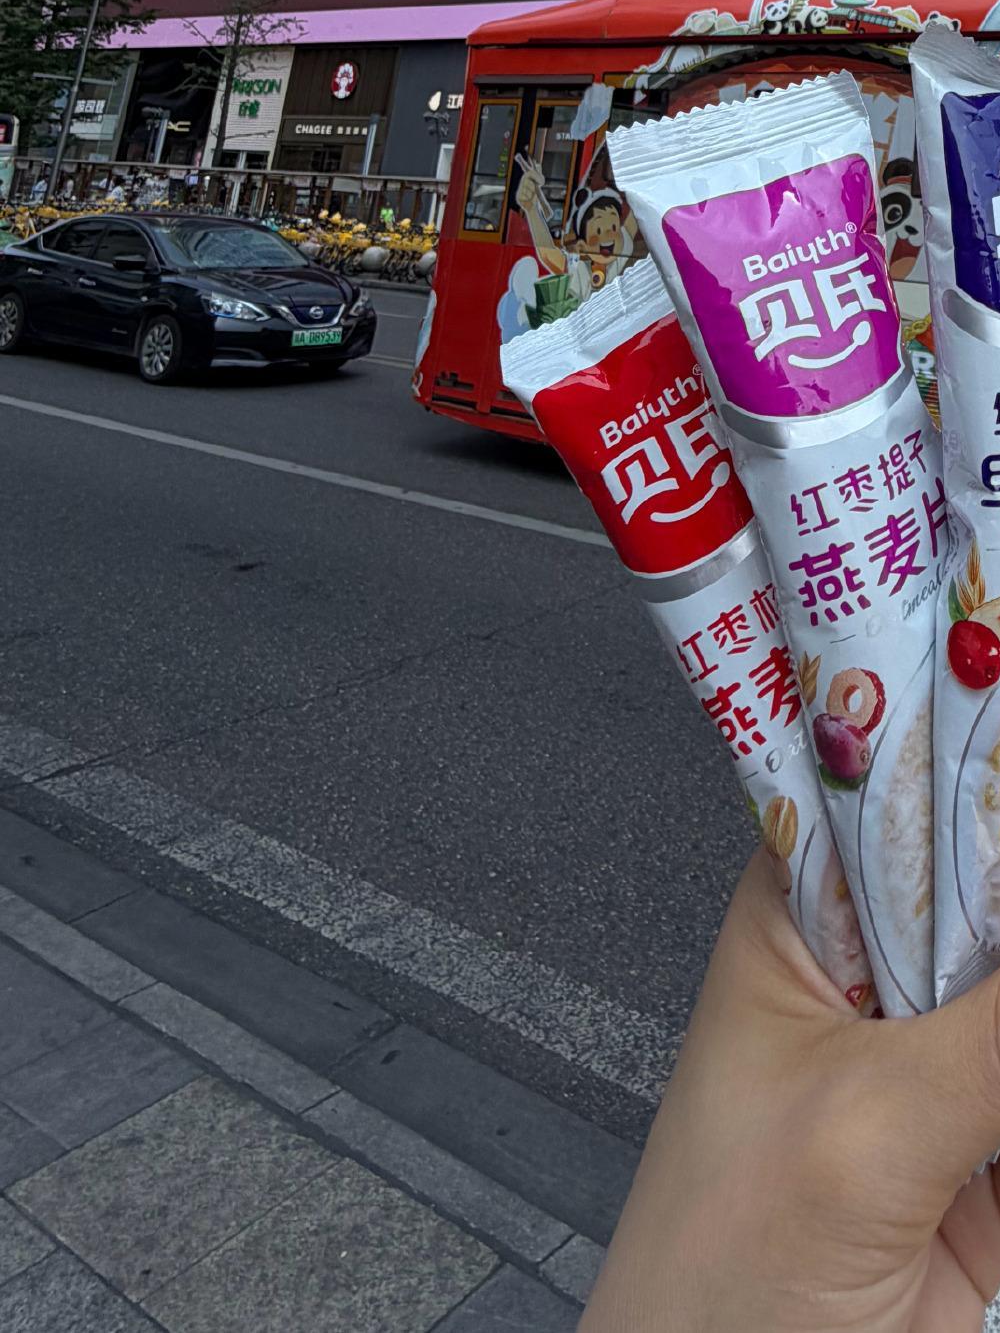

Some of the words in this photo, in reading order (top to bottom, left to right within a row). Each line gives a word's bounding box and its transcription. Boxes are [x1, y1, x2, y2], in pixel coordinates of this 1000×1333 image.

[232, 77, 282, 95] ARKSON
[738, 252, 887, 362] 贝氏
[790, 429, 927, 536] 红枣提子
